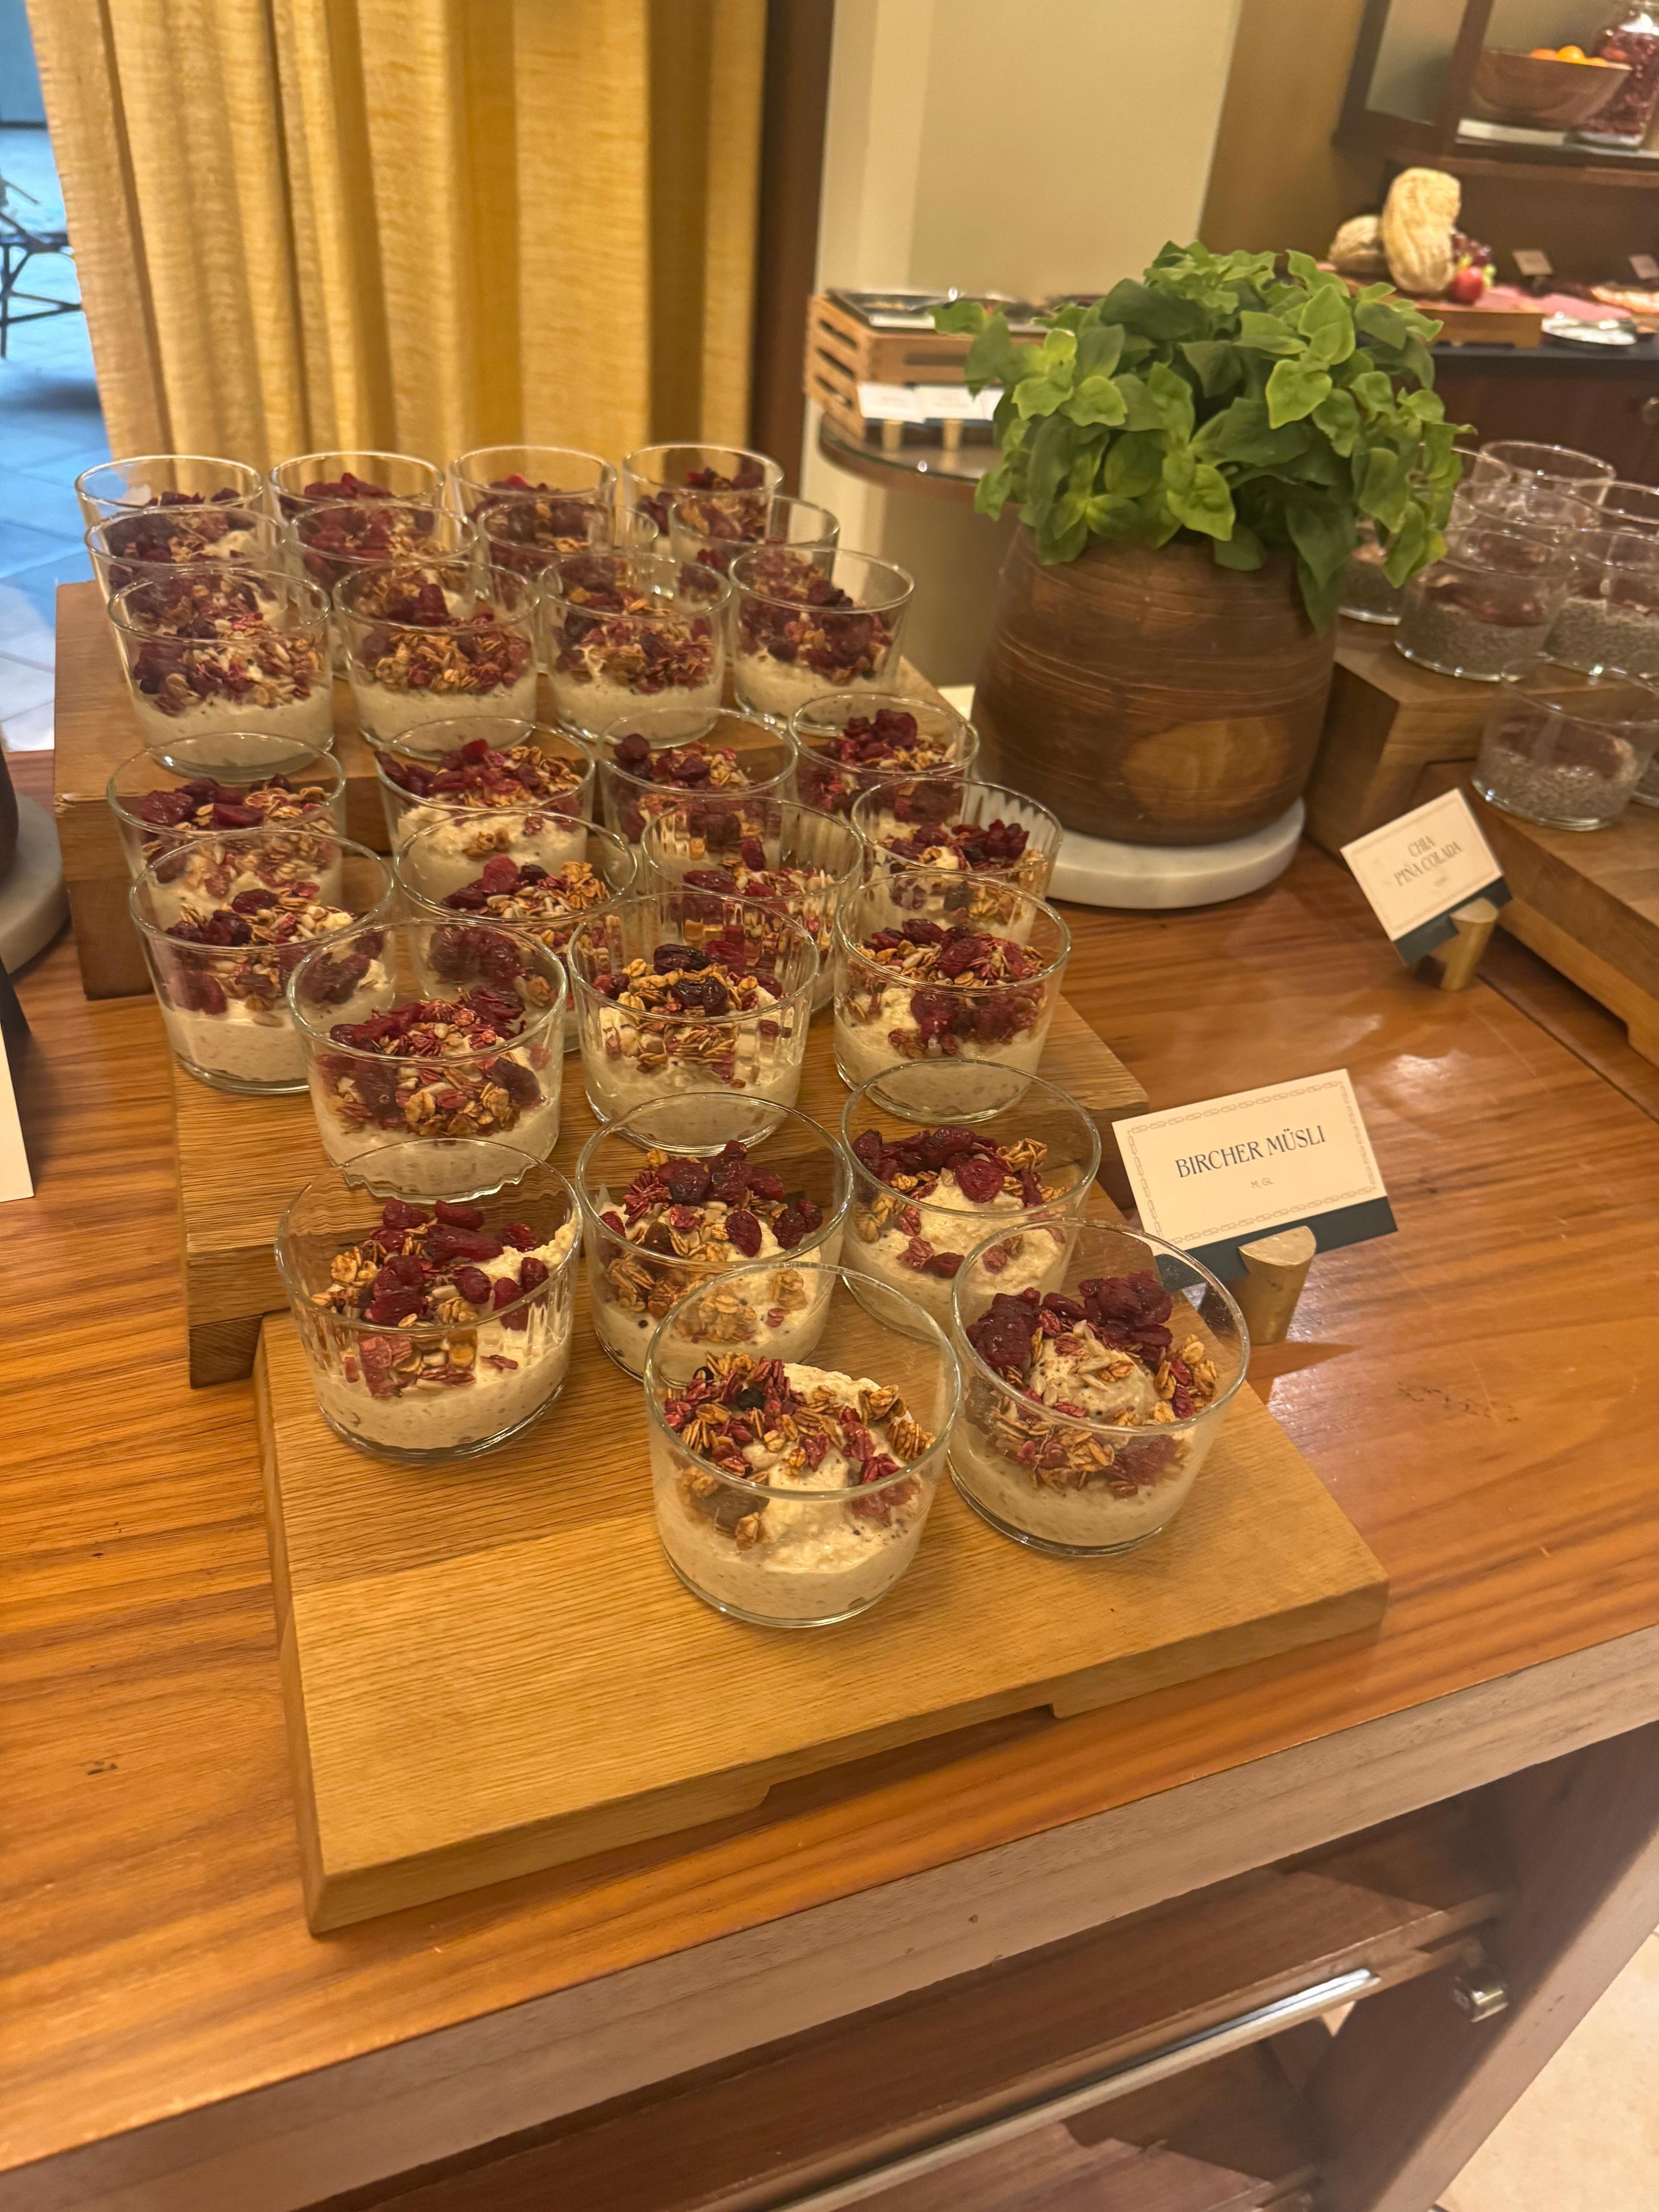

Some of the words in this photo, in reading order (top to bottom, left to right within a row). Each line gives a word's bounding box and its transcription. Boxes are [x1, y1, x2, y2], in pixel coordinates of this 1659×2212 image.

[1408, 836, 1435, 857] CHIA
[1421, 841, 1462, 871] COLADA
[1175, 1140, 1264, 1178] BIRCHER
[1266, 1125, 1326, 1156] MÜSLI
[1261, 1177, 1274, 1186] GL
